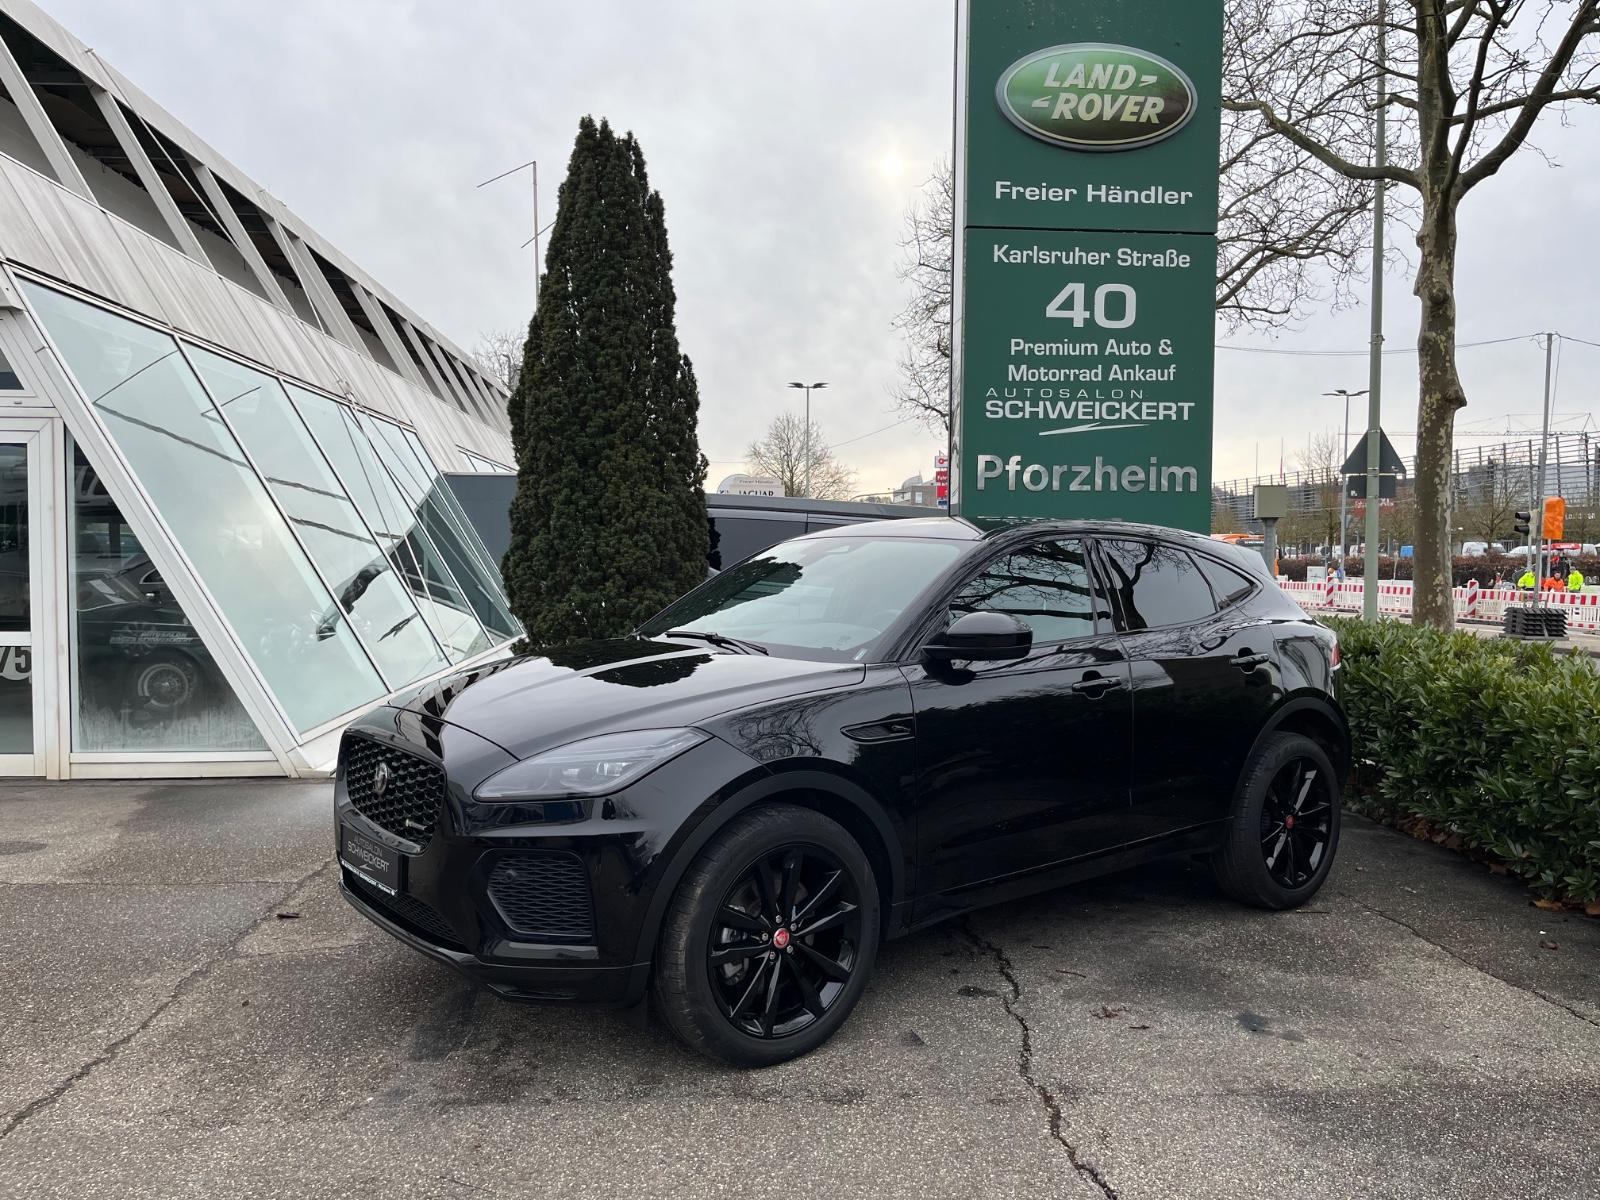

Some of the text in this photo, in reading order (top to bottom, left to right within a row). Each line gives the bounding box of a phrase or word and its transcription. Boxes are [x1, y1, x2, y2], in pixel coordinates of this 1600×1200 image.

[1043, 62, 1137, 91] LAND
[1051, 92, 1165, 124] ROVER
[995, 181, 1193, 205] Freier Händler
[993, 244, 1191, 268] Karlsruher Straße
[1045, 282, 1137, 329] 40
[1010, 338, 1173, 356] Premium Auto &
[1008, 364, 1176, 382] Motorrad Ankauf
[986, 387, 1143, 399] AUTOSALON
[985, 400, 1195, 421] SCHWEICKERT
[976, 454, 1198, 493] Pforzheim
